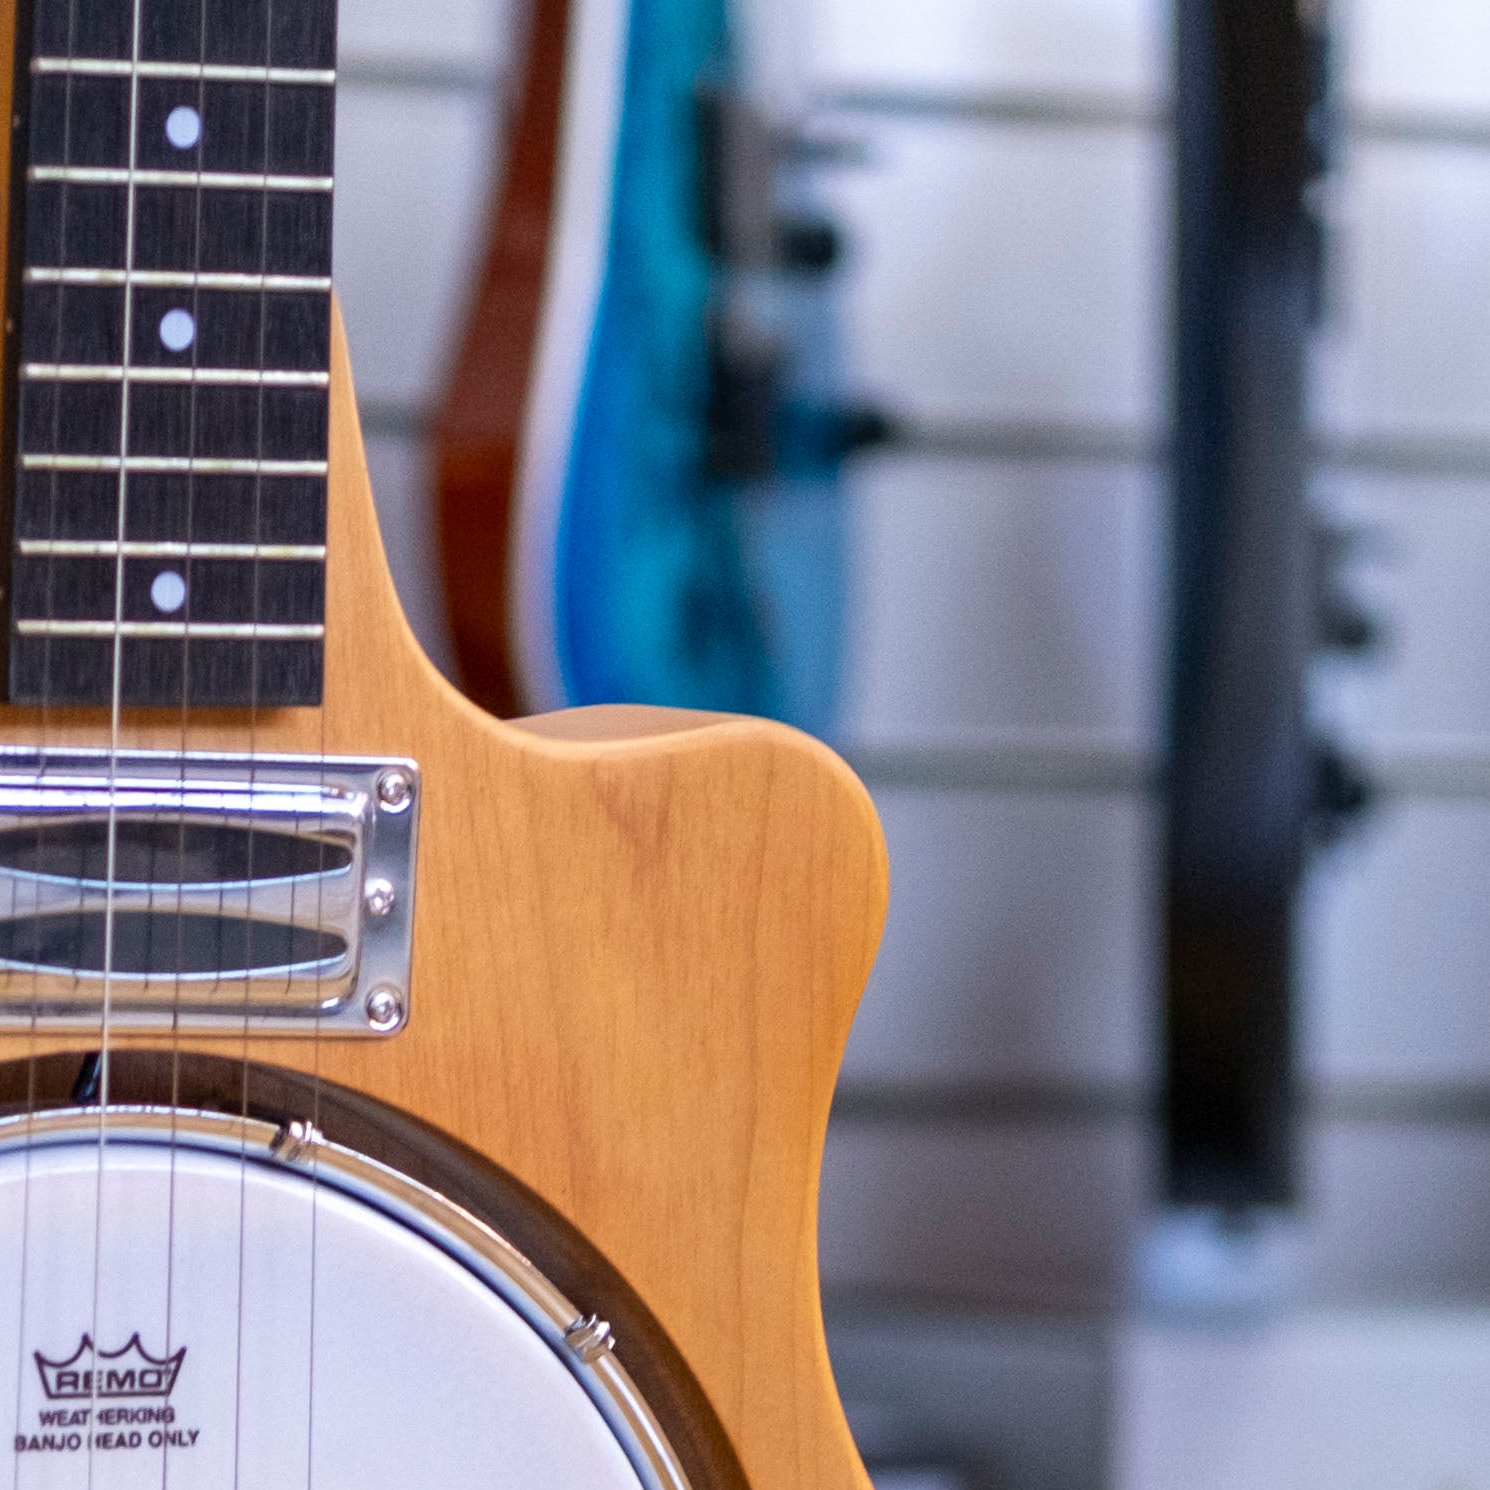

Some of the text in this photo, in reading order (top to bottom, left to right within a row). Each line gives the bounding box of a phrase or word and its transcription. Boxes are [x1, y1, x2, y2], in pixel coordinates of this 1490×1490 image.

[55, 1369, 164, 1391] REMO
[15, 1428, 200, 1452] BANJO HEAD ONLY
